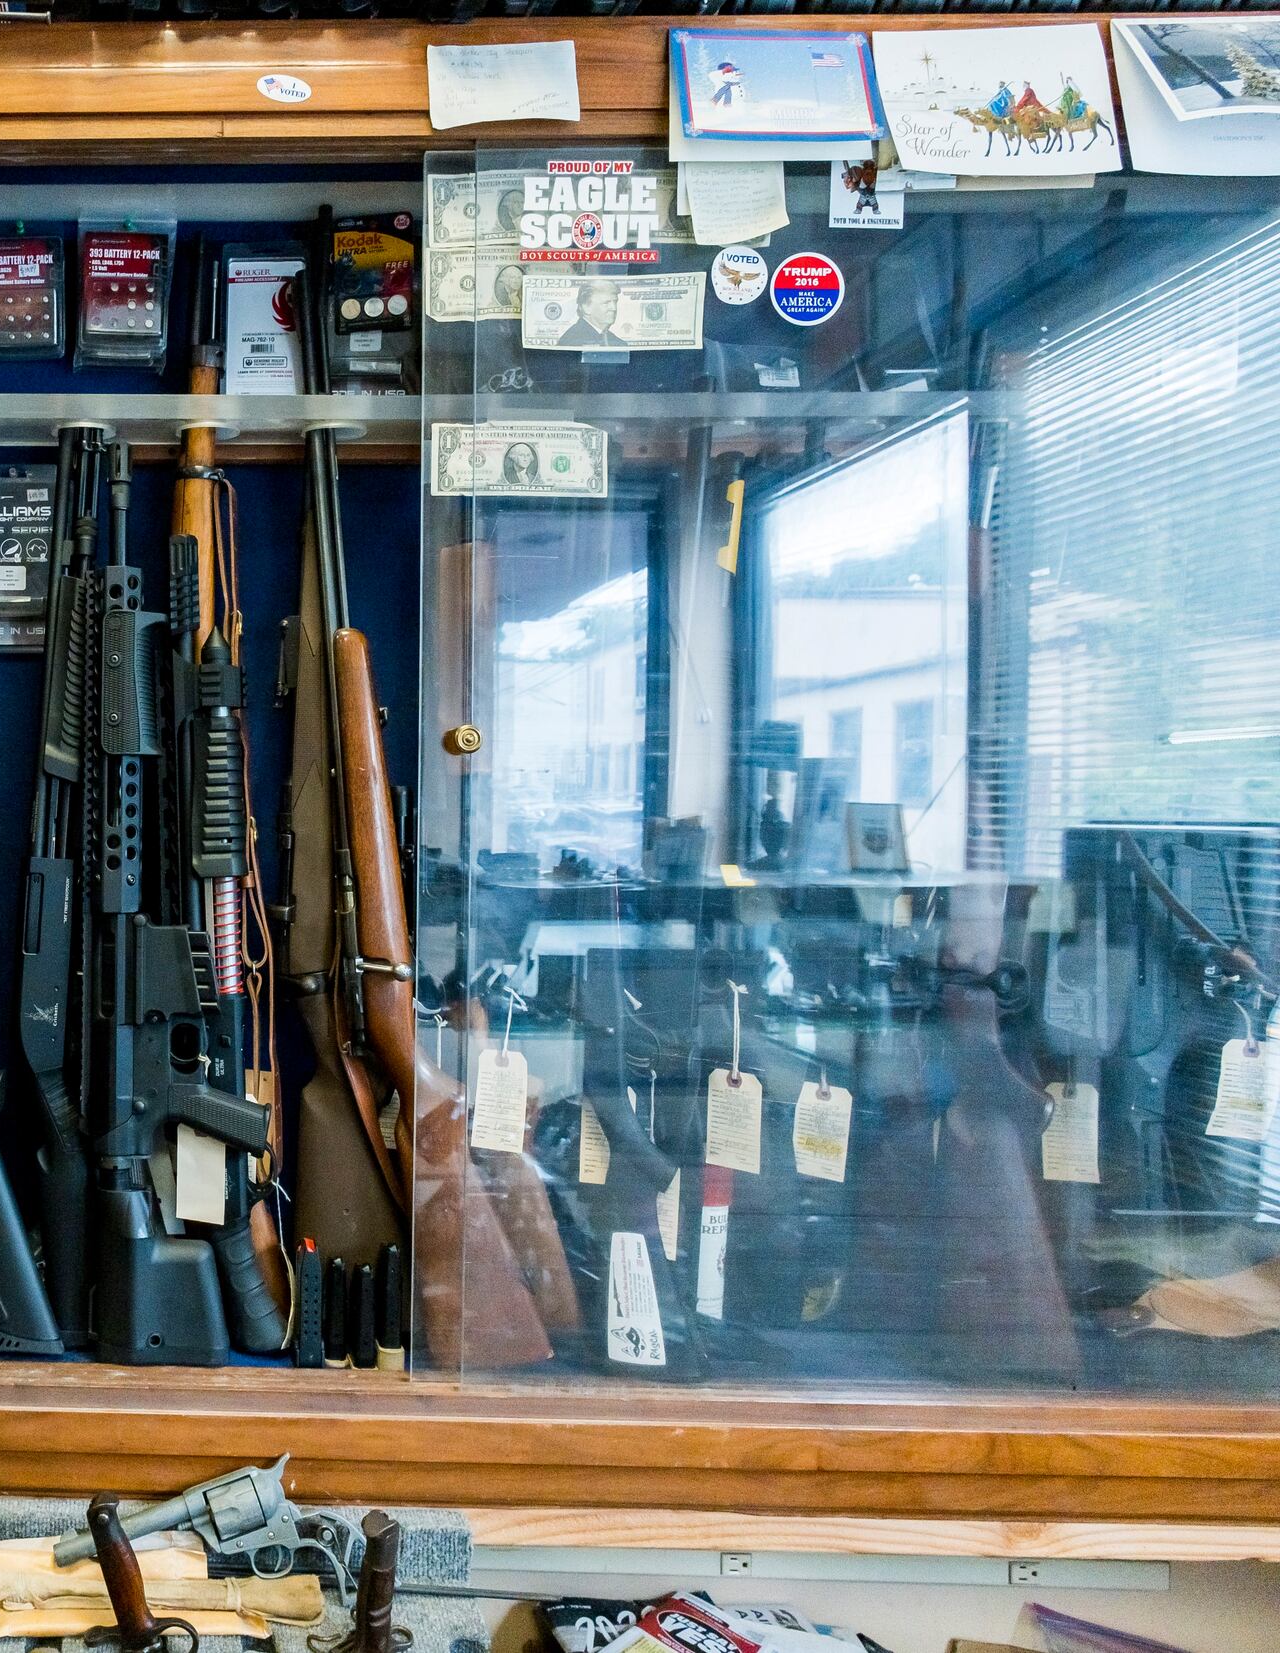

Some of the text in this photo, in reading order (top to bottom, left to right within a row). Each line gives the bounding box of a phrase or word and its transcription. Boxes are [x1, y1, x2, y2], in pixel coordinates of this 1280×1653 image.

[280, 88, 306, 98] VOTED
[896, 113, 957, 142] Star of
[906, 136, 971, 158] Wonder
[549, 162, 633, 172] PROUD OF MY
[523, 176, 657, 211] EAGLE
[520, 212, 659, 249] SCOUT
[337, 233, 382, 248] Kodak
[89, 249, 160, 260] 393 BATTERY 12-PACK
[337, 246, 367, 257] ULTRA
[522, 252, 656, 260] BOY SCOUTS of AMERICA
[27, 254, 53, 264] 12-PACK
[721, 252, 759, 264] I VOTED
[385, 261, 409, 269] FREE
[782, 267, 832, 277] TRUMP
[795, 278, 819, 286] 2016
[780, 297, 833, 307] AMERICA
[10, 627, 20, 635] IN
[650, 1329, 660, 1360] RASCAL
[669, 1613, 739, 1650] JUST SAY
